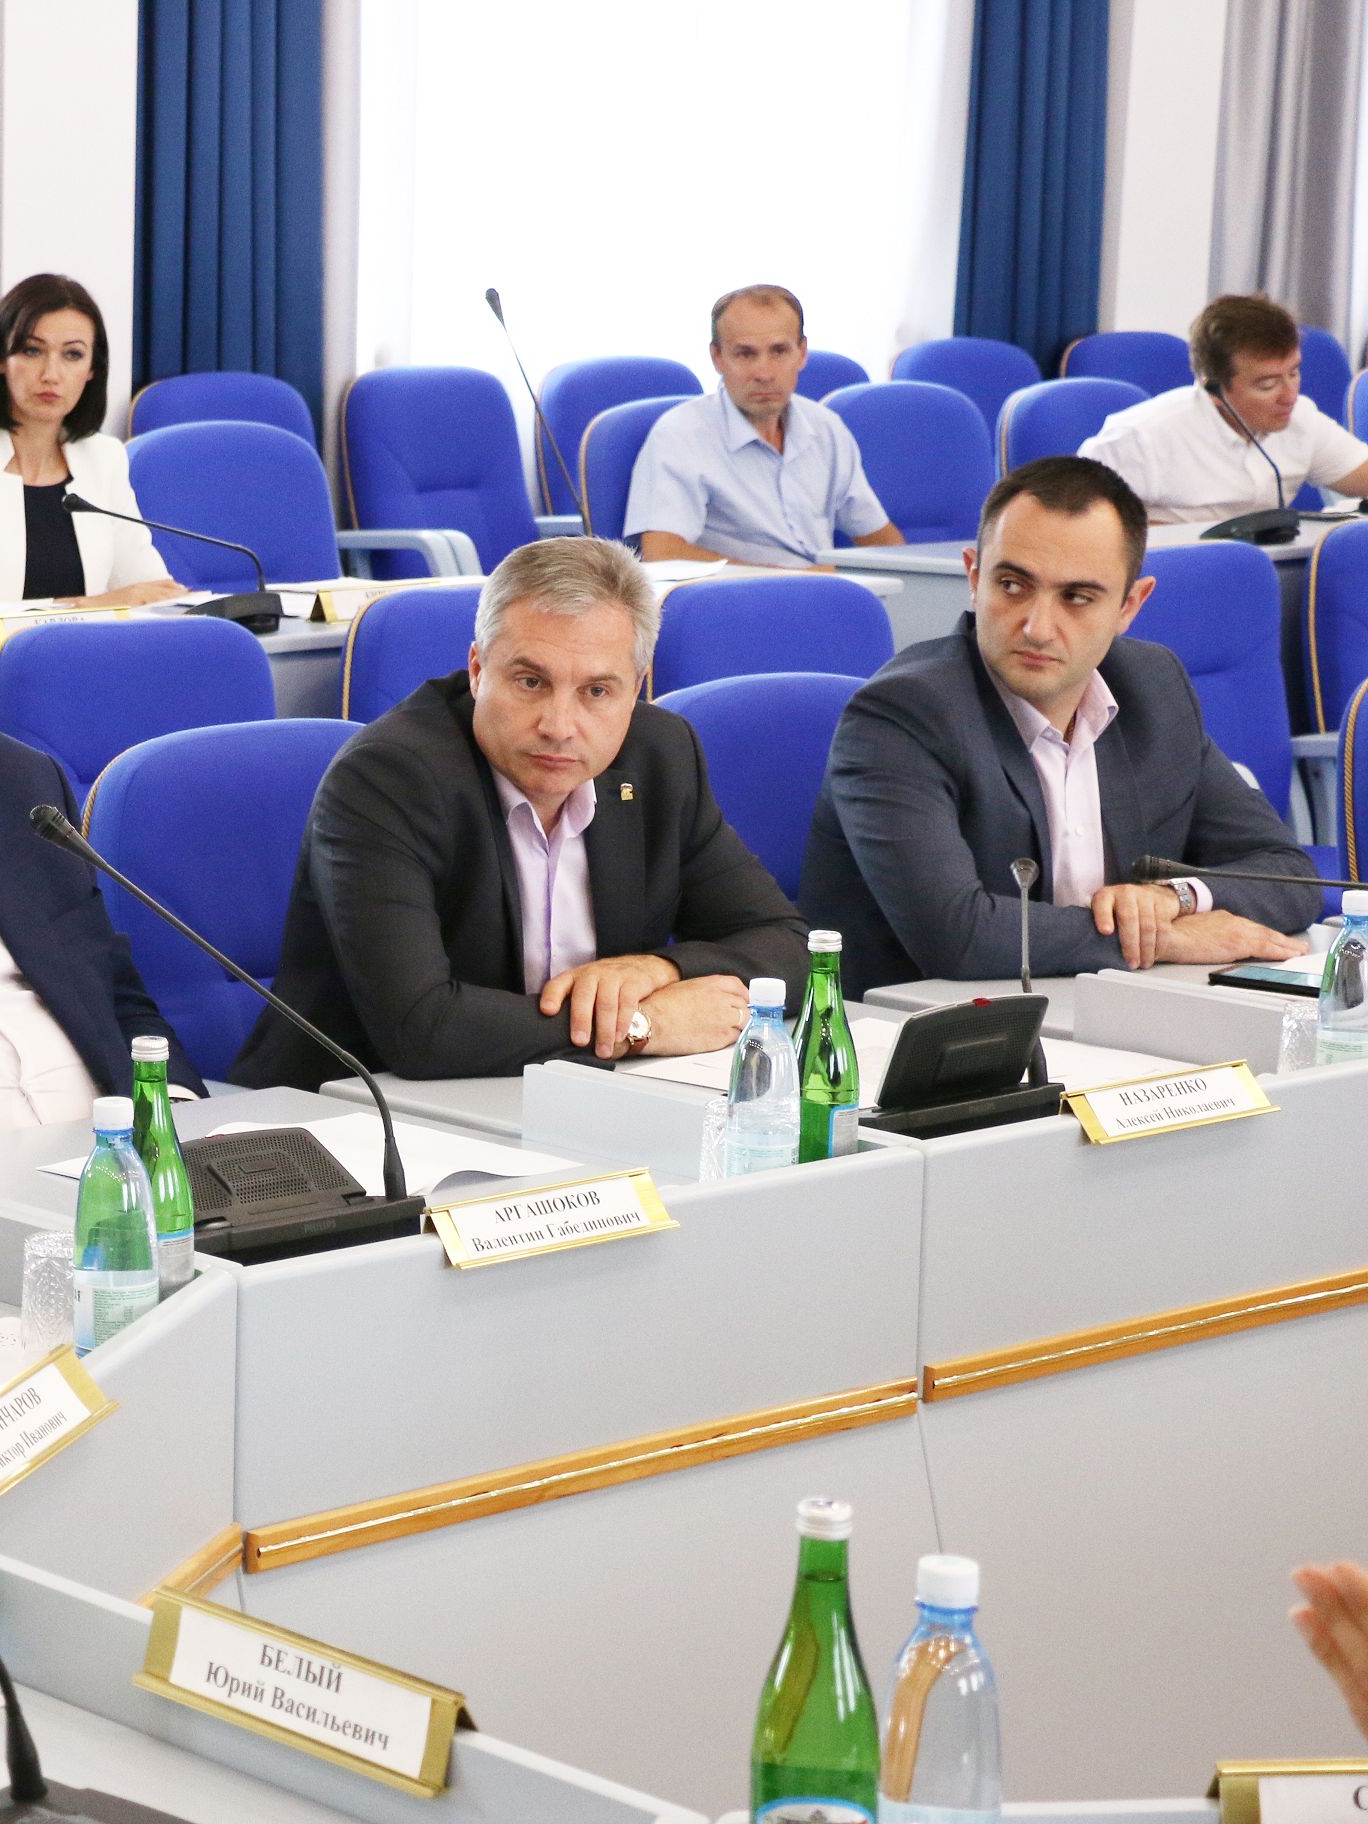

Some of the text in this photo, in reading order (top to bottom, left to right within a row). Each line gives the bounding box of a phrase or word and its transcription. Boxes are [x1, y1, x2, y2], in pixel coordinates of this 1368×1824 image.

[1119, 1078, 1207, 1107] НАЗАРЕНКО
[1115, 1098, 1235, 1129] Алексей Николаевич
[494, 1191, 600, 1224] АРГАШОКОВ
[472, 1211, 641, 1253] Валентин Габединович
[20, 1411, 68, 1449] Иванович
[259, 1644, 344, 1693] БЕЛЫЙ
[205, 1662, 390, 1751] Юрий Васильевич
